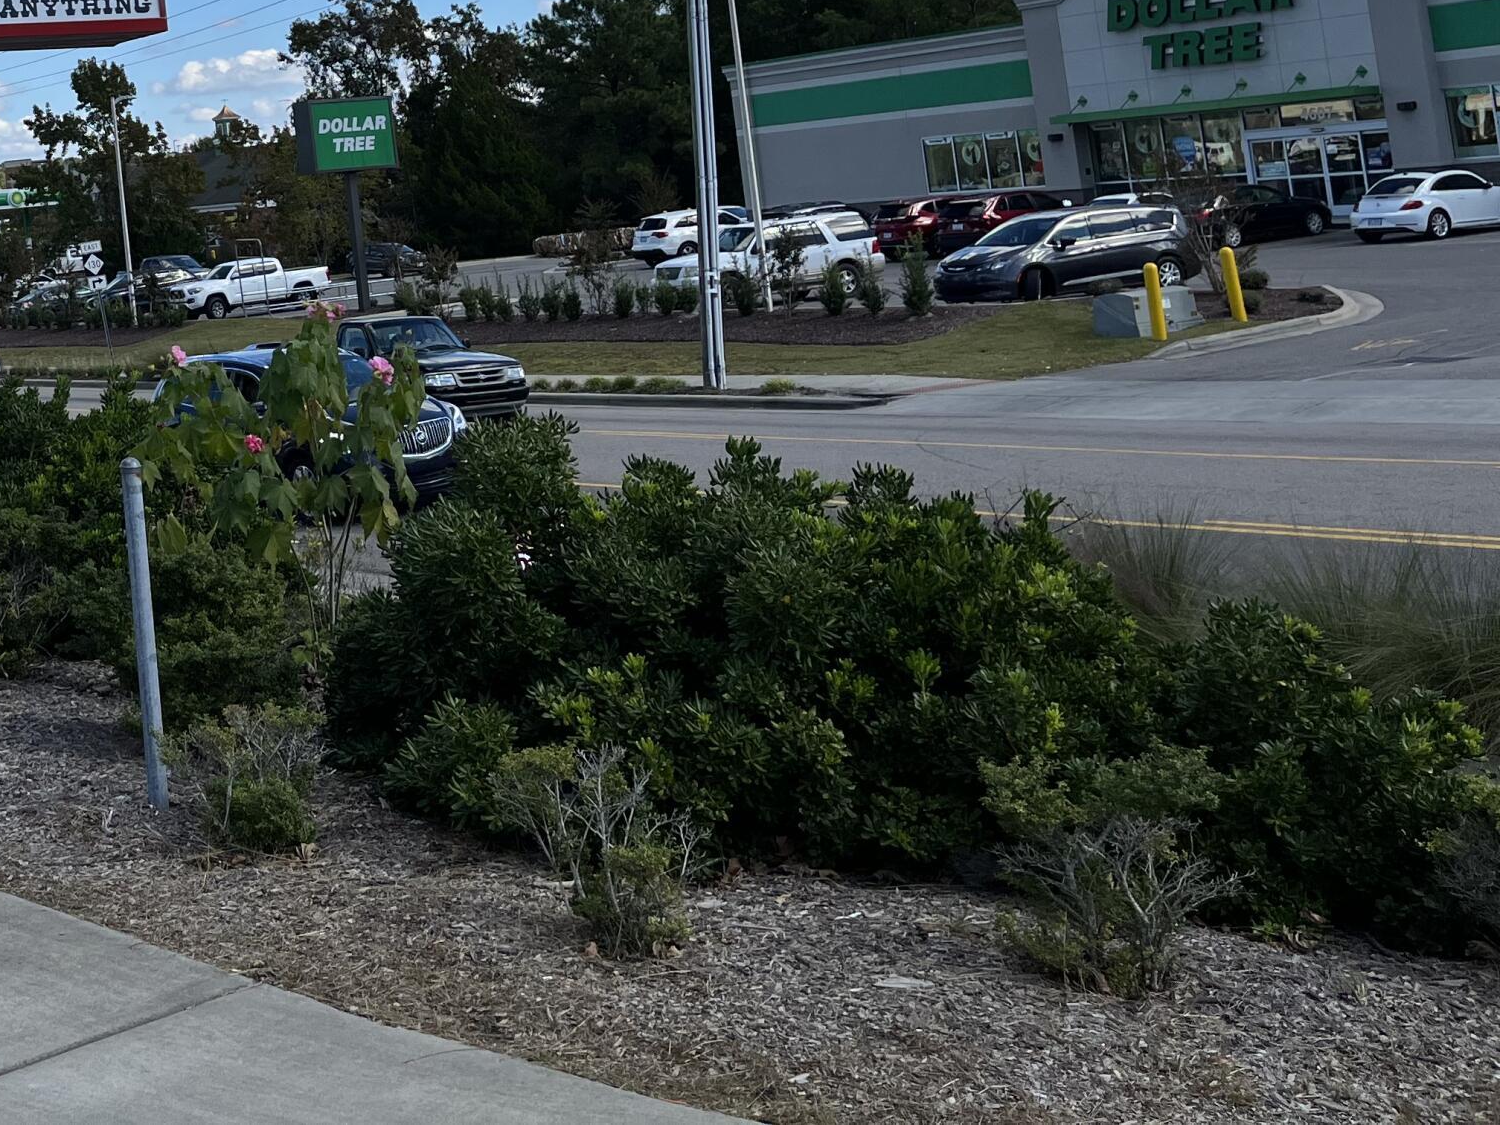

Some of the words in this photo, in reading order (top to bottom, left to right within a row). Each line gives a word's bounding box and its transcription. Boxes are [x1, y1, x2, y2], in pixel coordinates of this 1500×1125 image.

[1142, 22, 1263, 70] TREE
[318, 115, 387, 135] DOLLAR
[332, 135, 376, 153] TREE
[83, 243, 99, 252] EAST
[88, 259, 101, 269] 130
